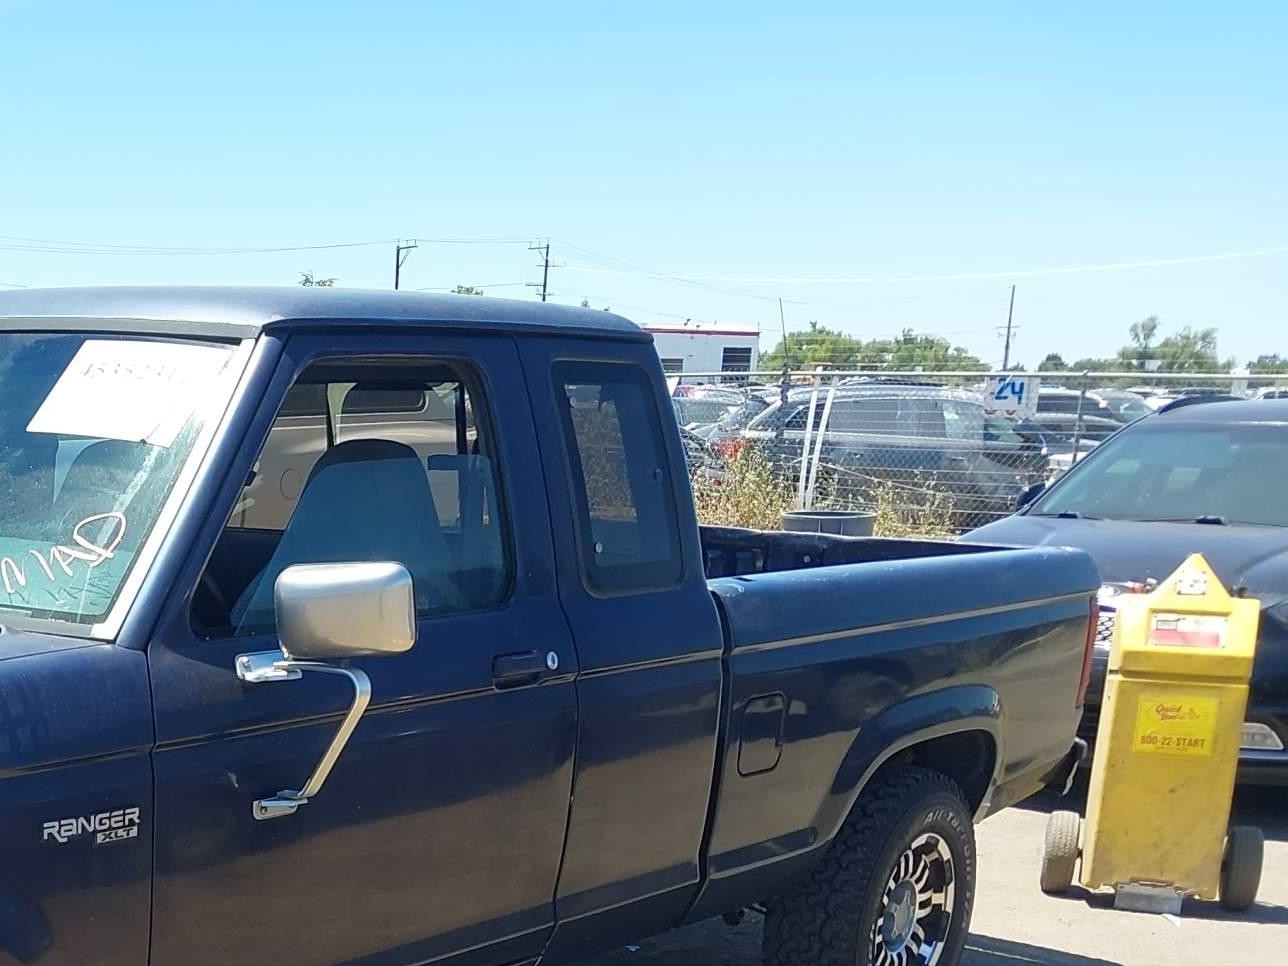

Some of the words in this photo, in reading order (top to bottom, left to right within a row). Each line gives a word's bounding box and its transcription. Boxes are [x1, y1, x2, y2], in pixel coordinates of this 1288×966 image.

[994, 377, 1025, 405] 24
[43, 807, 140, 842] RANGER
[101, 827, 133, 841] XLT
